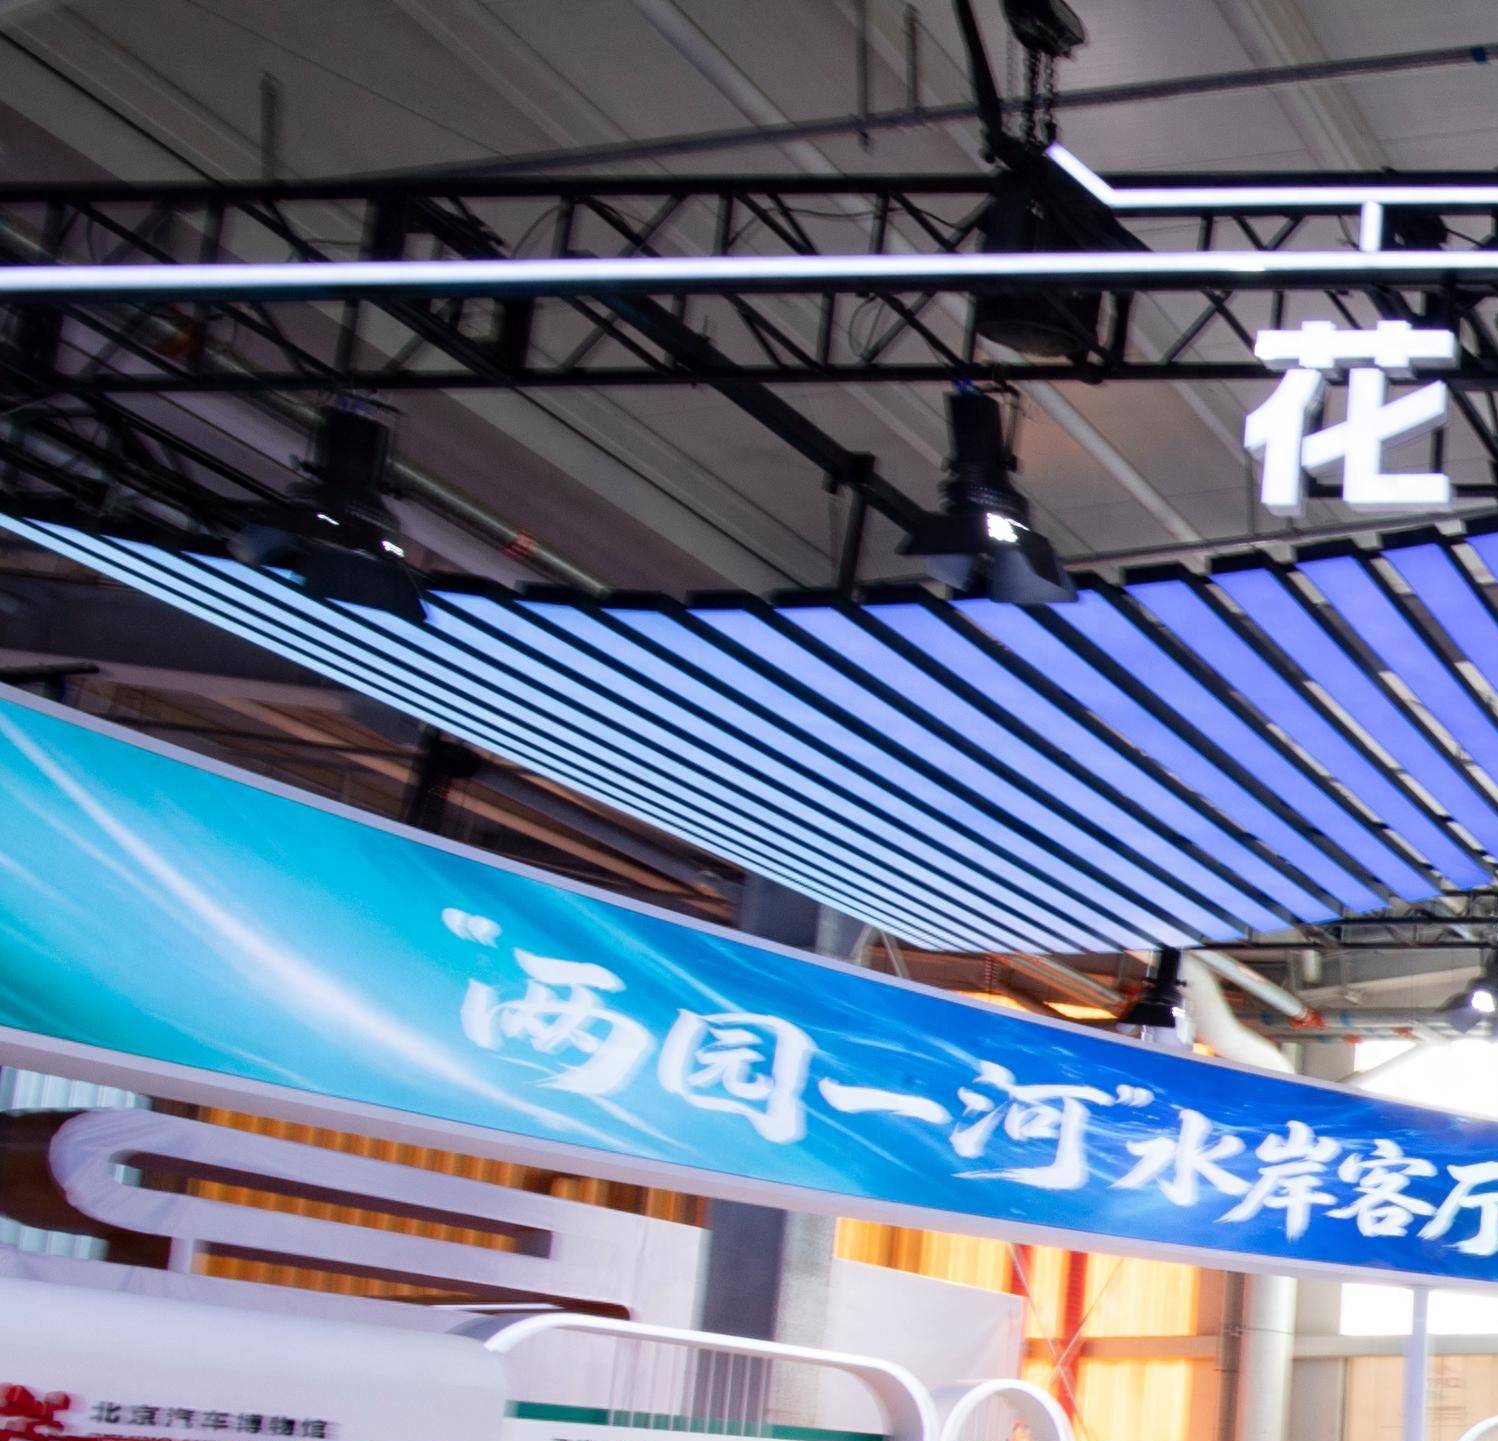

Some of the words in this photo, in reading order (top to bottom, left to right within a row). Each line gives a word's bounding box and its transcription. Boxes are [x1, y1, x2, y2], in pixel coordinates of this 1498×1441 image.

[90, 1400, 332, 1440] 北京汽车博物馆
